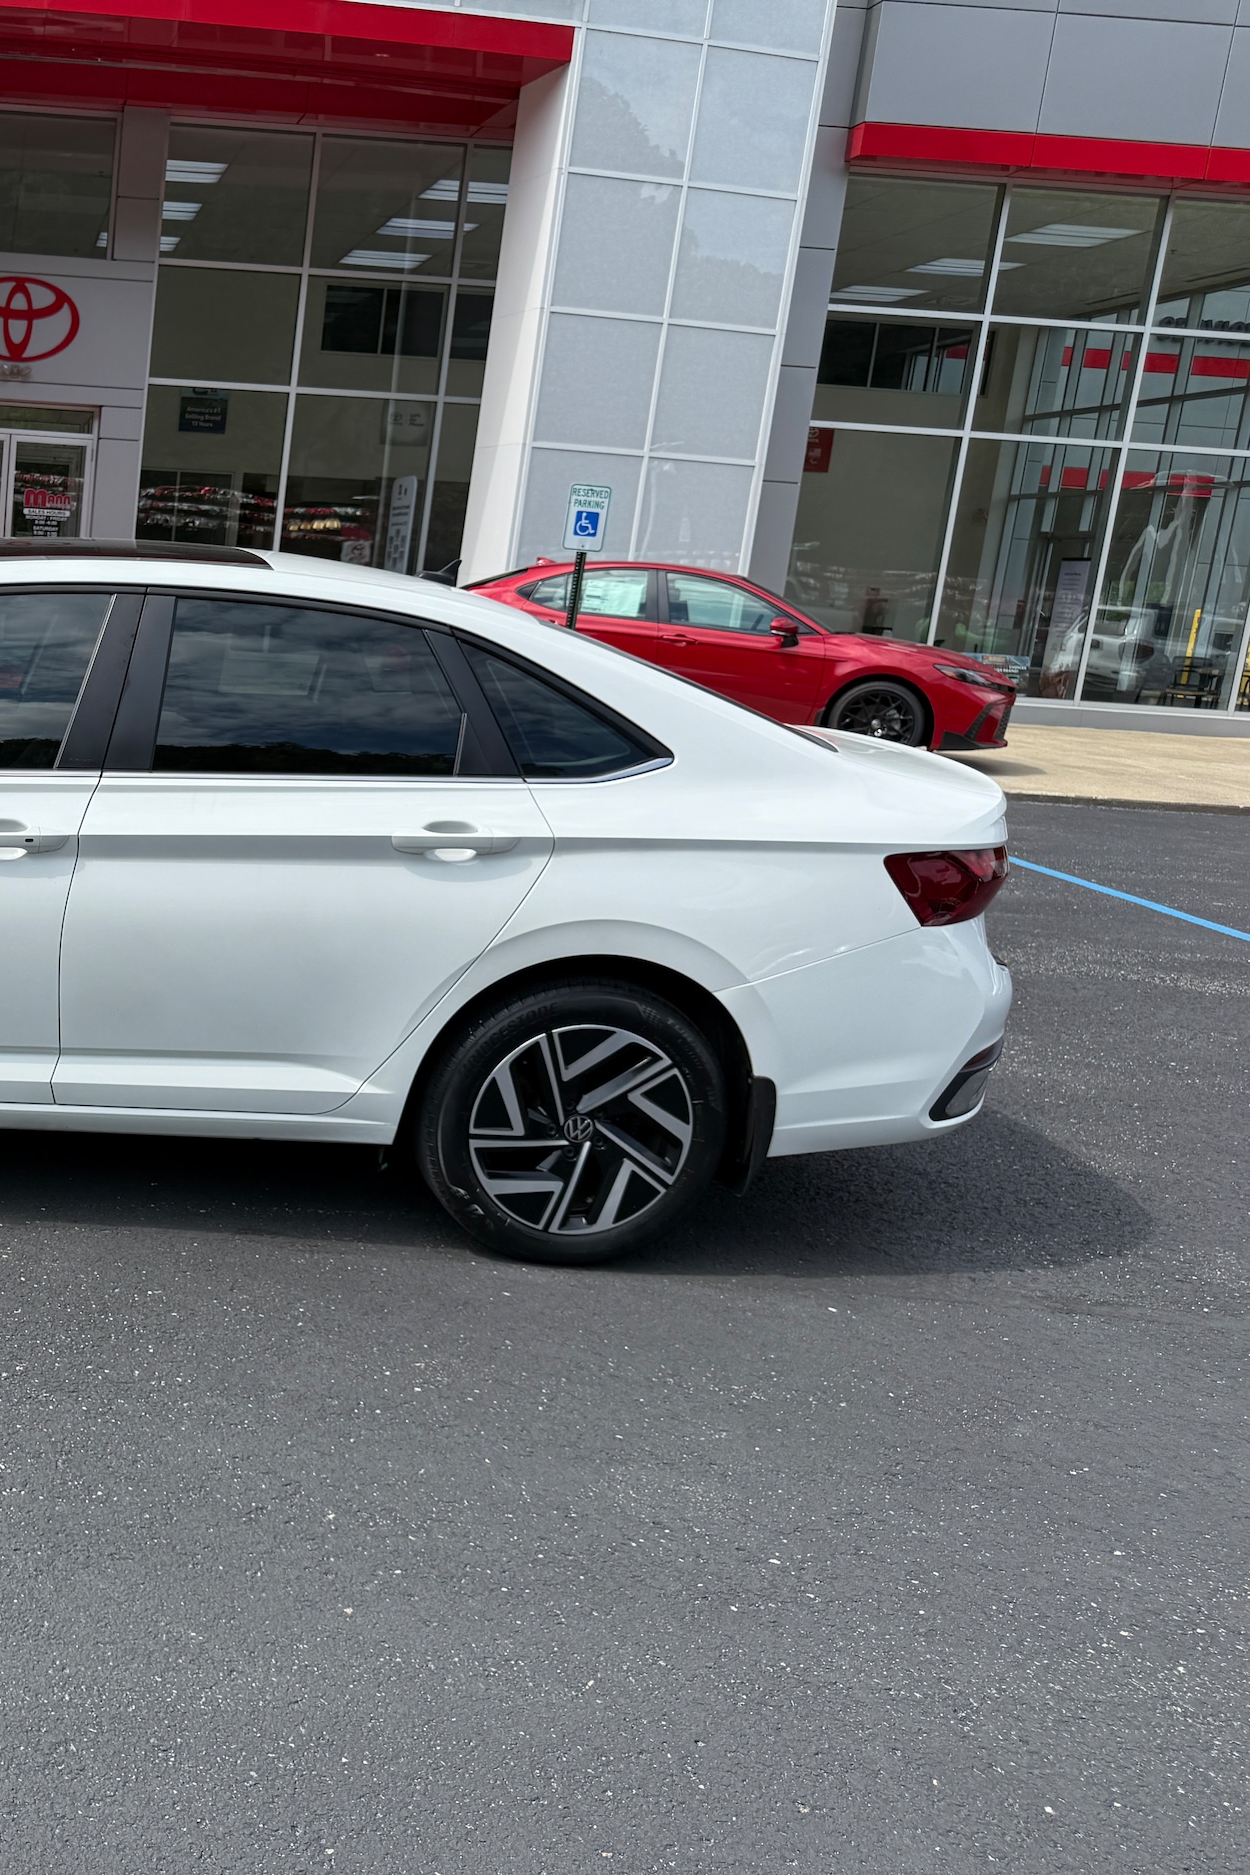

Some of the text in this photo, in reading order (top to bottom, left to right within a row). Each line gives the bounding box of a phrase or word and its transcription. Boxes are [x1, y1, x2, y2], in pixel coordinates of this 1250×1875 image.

[571, 488, 609, 499] RESERVED
[573, 499, 605, 510] PARKING
[459, 1001, 560, 1076] BRIDGESTONE
